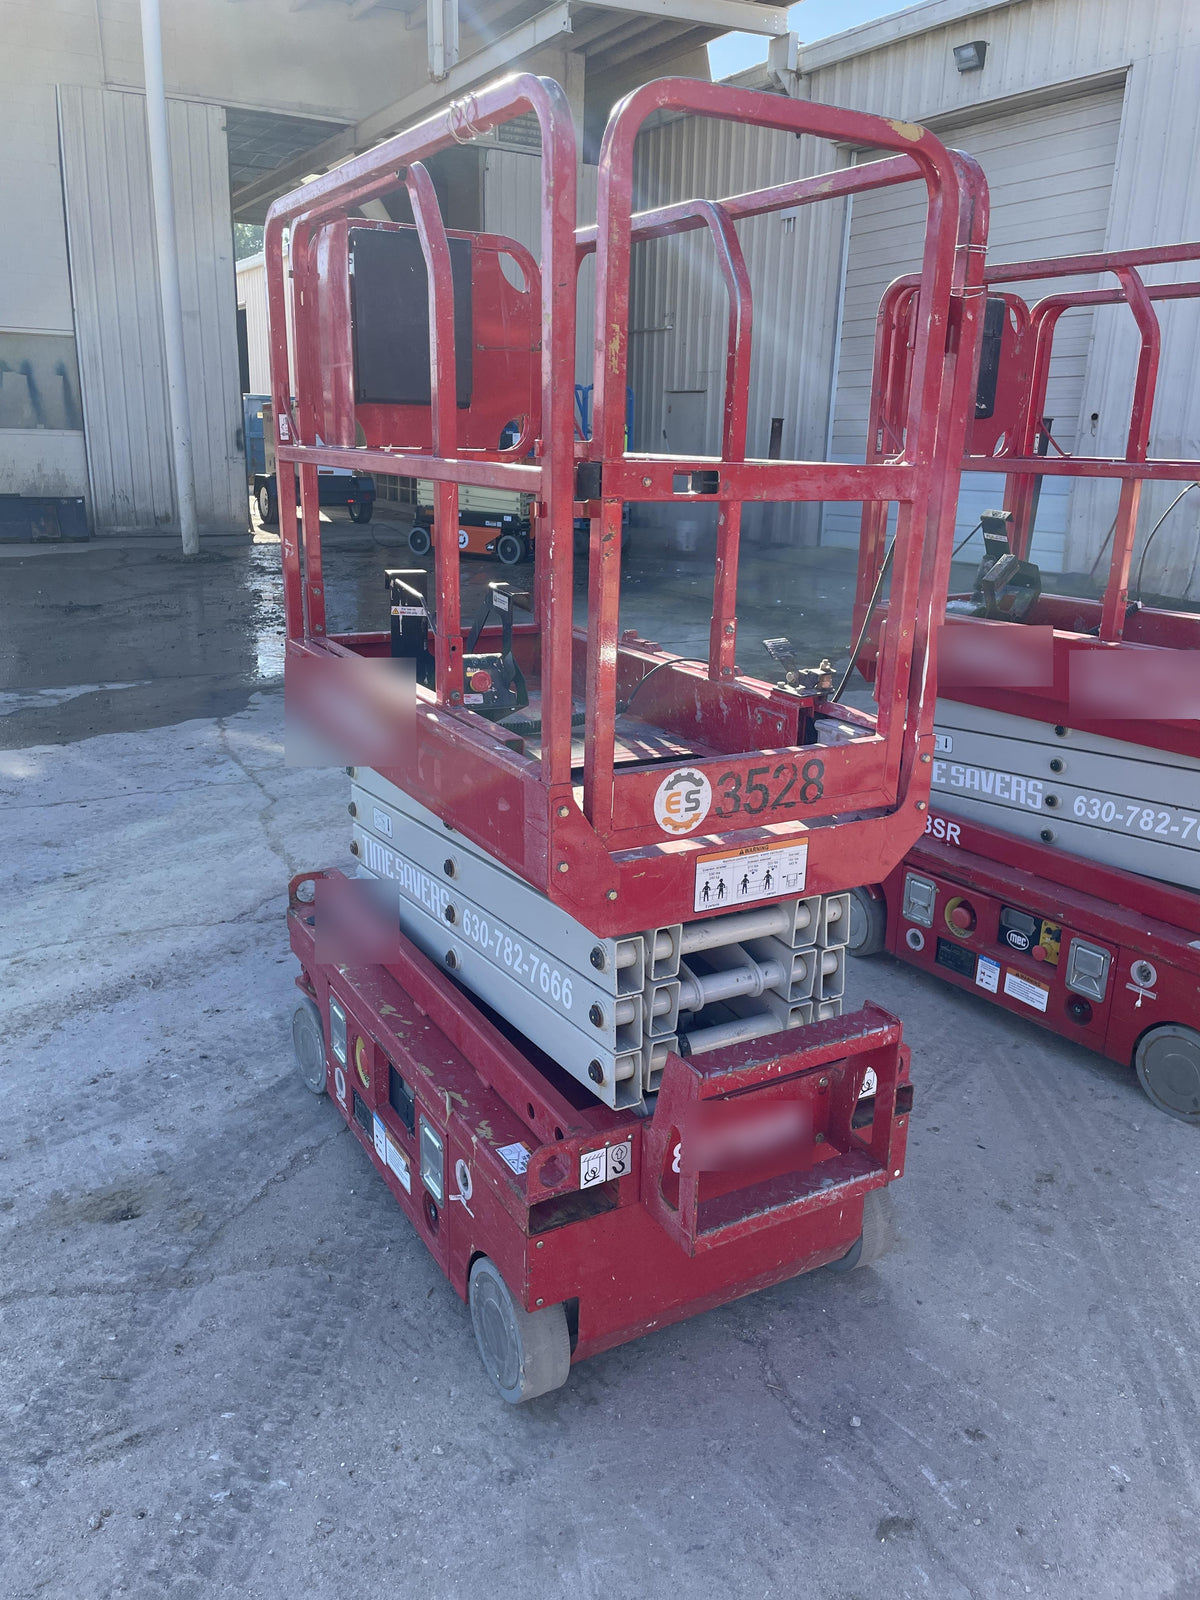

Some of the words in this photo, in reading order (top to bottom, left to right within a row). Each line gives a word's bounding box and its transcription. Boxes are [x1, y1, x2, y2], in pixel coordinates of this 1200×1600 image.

[665, 789, 701, 813] ES
[715, 758, 825, 818] 3528
[950, 766, 1043, 809] SAVERS
[1073, 795, 1200, 844] 630-782-7
[744, 845, 769, 855] WARNING
[362, 833, 394, 879] TIME
[395, 857, 451, 927] SAVERS
[462, 908, 573, 1010] 630-782-7666
